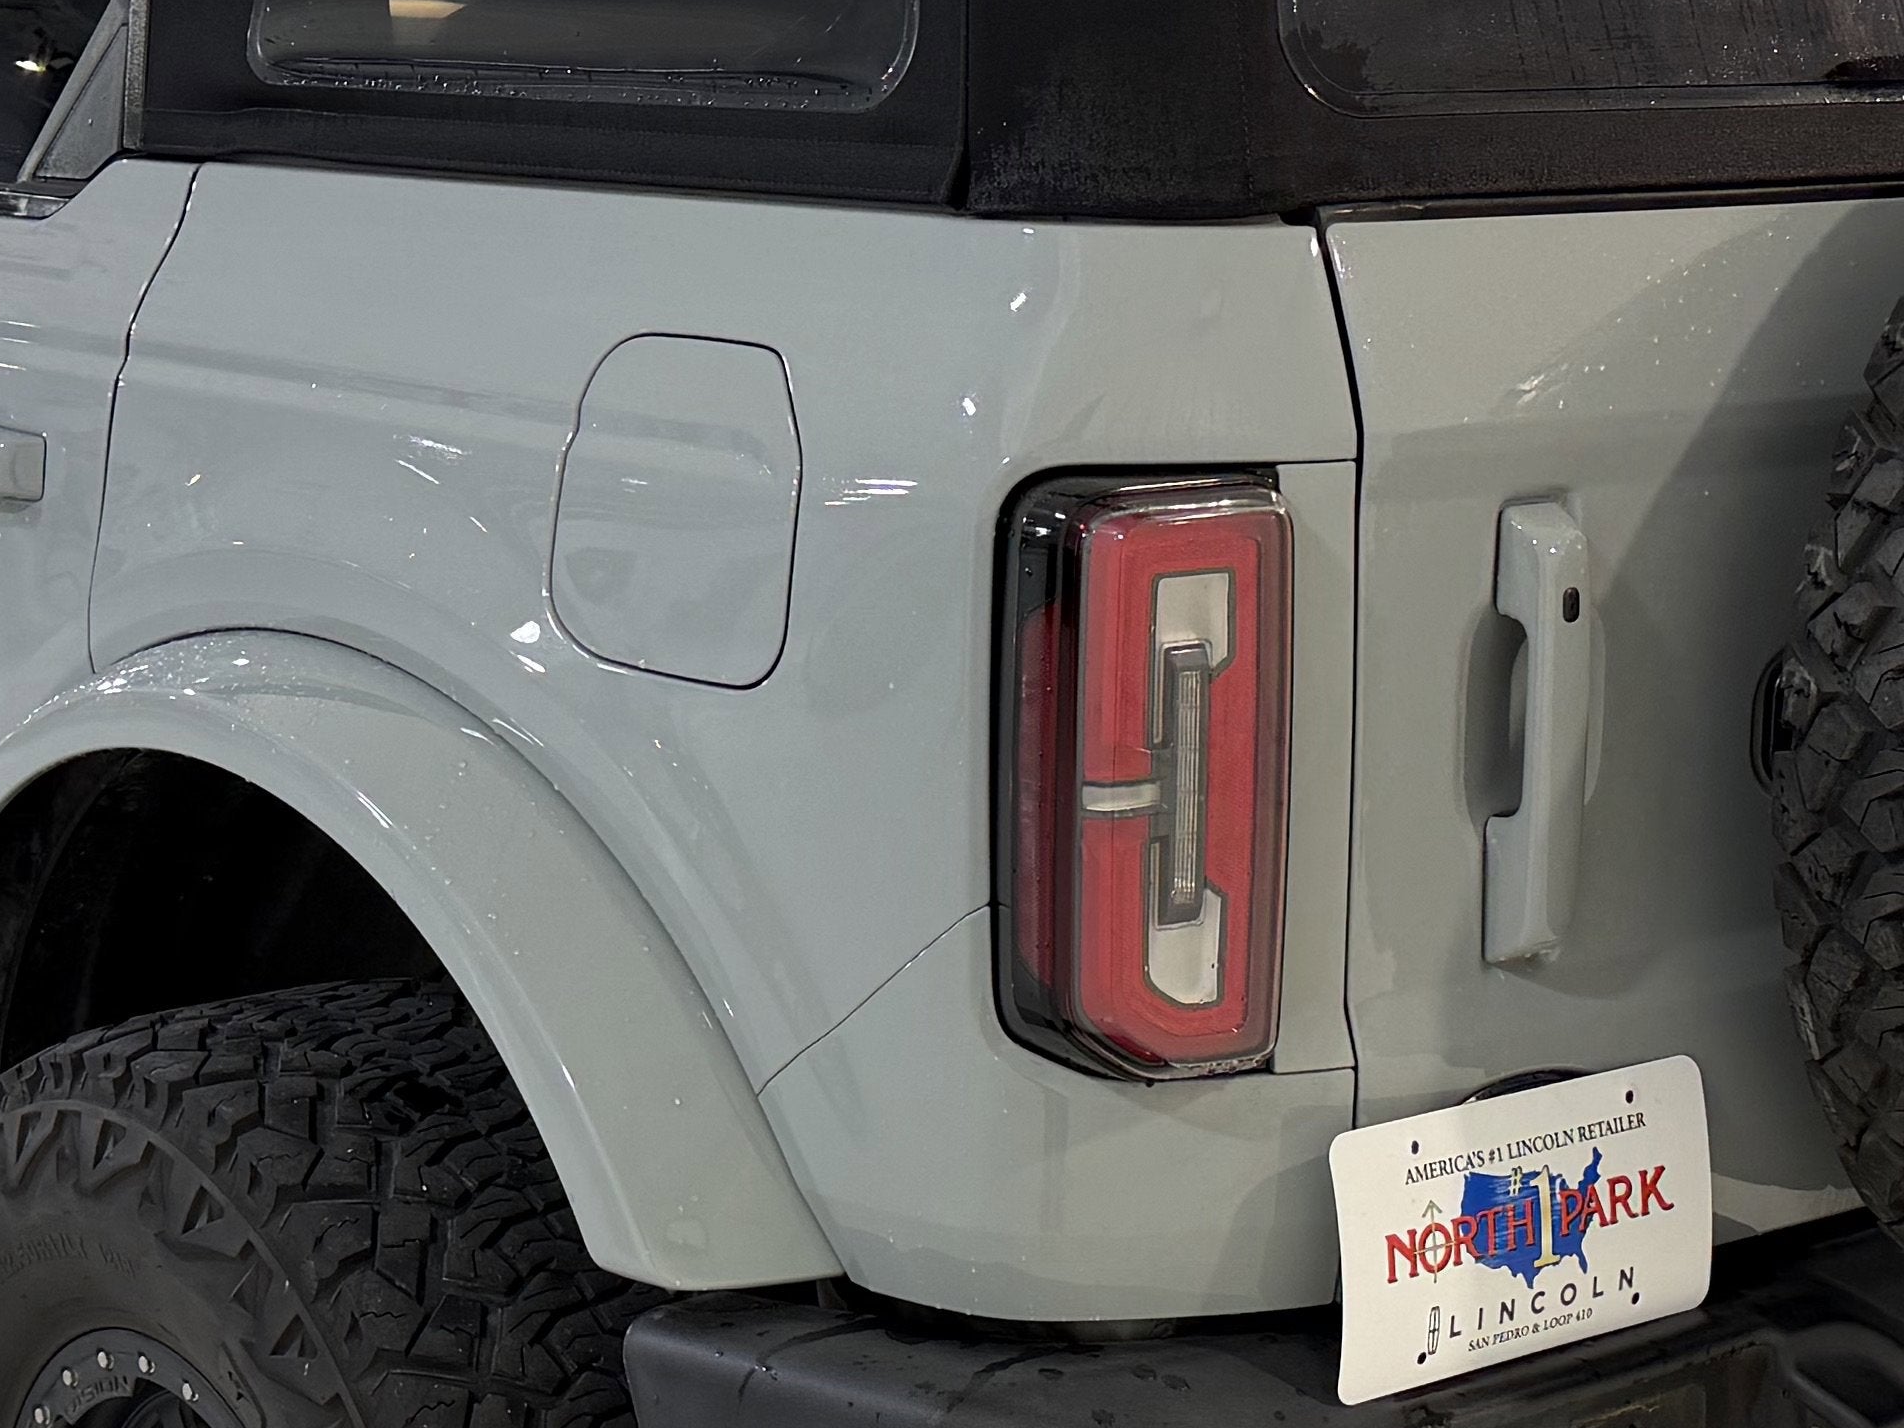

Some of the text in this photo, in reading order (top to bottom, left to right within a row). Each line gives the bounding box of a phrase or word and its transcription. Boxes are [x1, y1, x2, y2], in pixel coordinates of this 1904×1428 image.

[1405, 1112, 1647, 1185] AMERICA'S #1 LINCOLN RETAILER
[1385, 1165, 1674, 1284] NORTH PARK
[1449, 1266, 1634, 1338] LINCOLN
[1468, 1307, 1593, 1352] SAN PEDRO & LOOP 410
